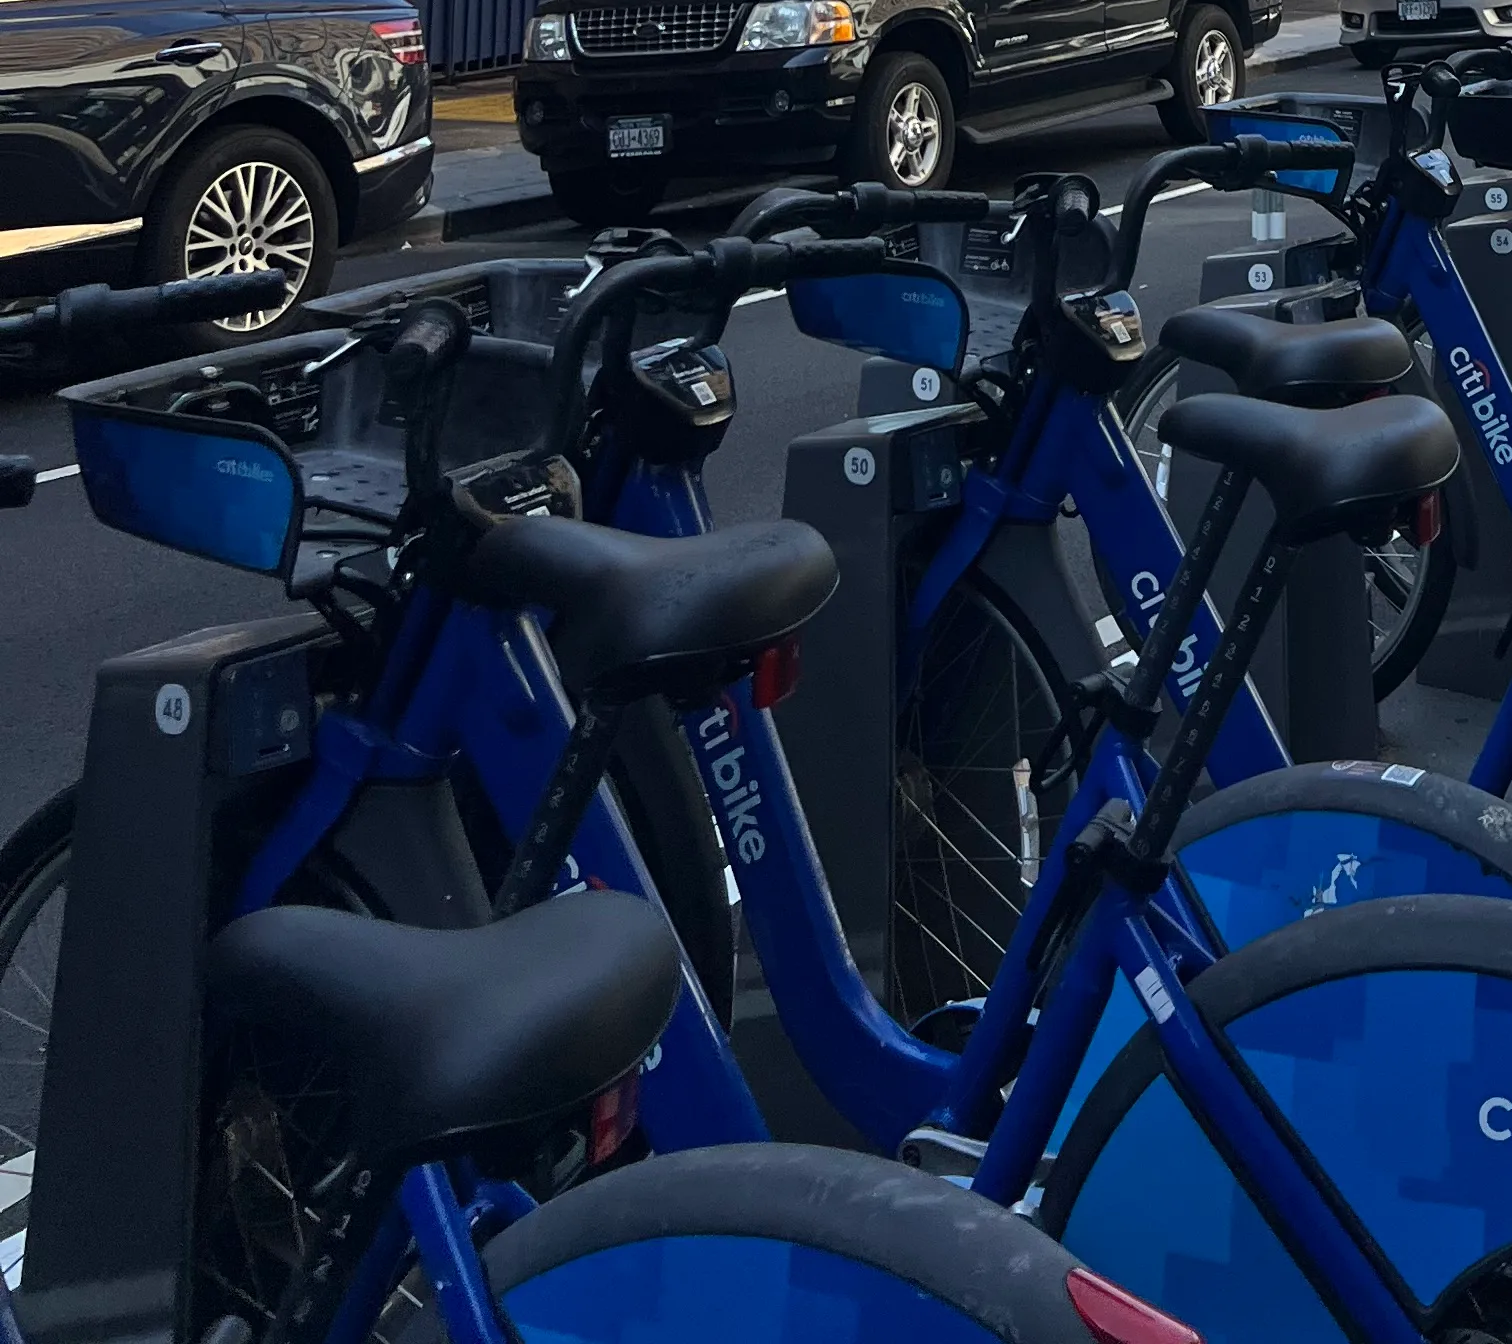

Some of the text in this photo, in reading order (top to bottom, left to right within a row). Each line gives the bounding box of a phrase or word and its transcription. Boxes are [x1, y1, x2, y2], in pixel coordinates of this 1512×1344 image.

[1490, 193, 1502, 204] 55
[1496, 235, 1510, 247] 54
[1254, 270, 1267, 283] 53
[1449, 347, 1486, 398] citi
[920, 377, 933, 393] 51
[851, 457, 869, 476] 50
[163, 698, 183, 721] 48
[699, 707, 766, 864] ti bike
